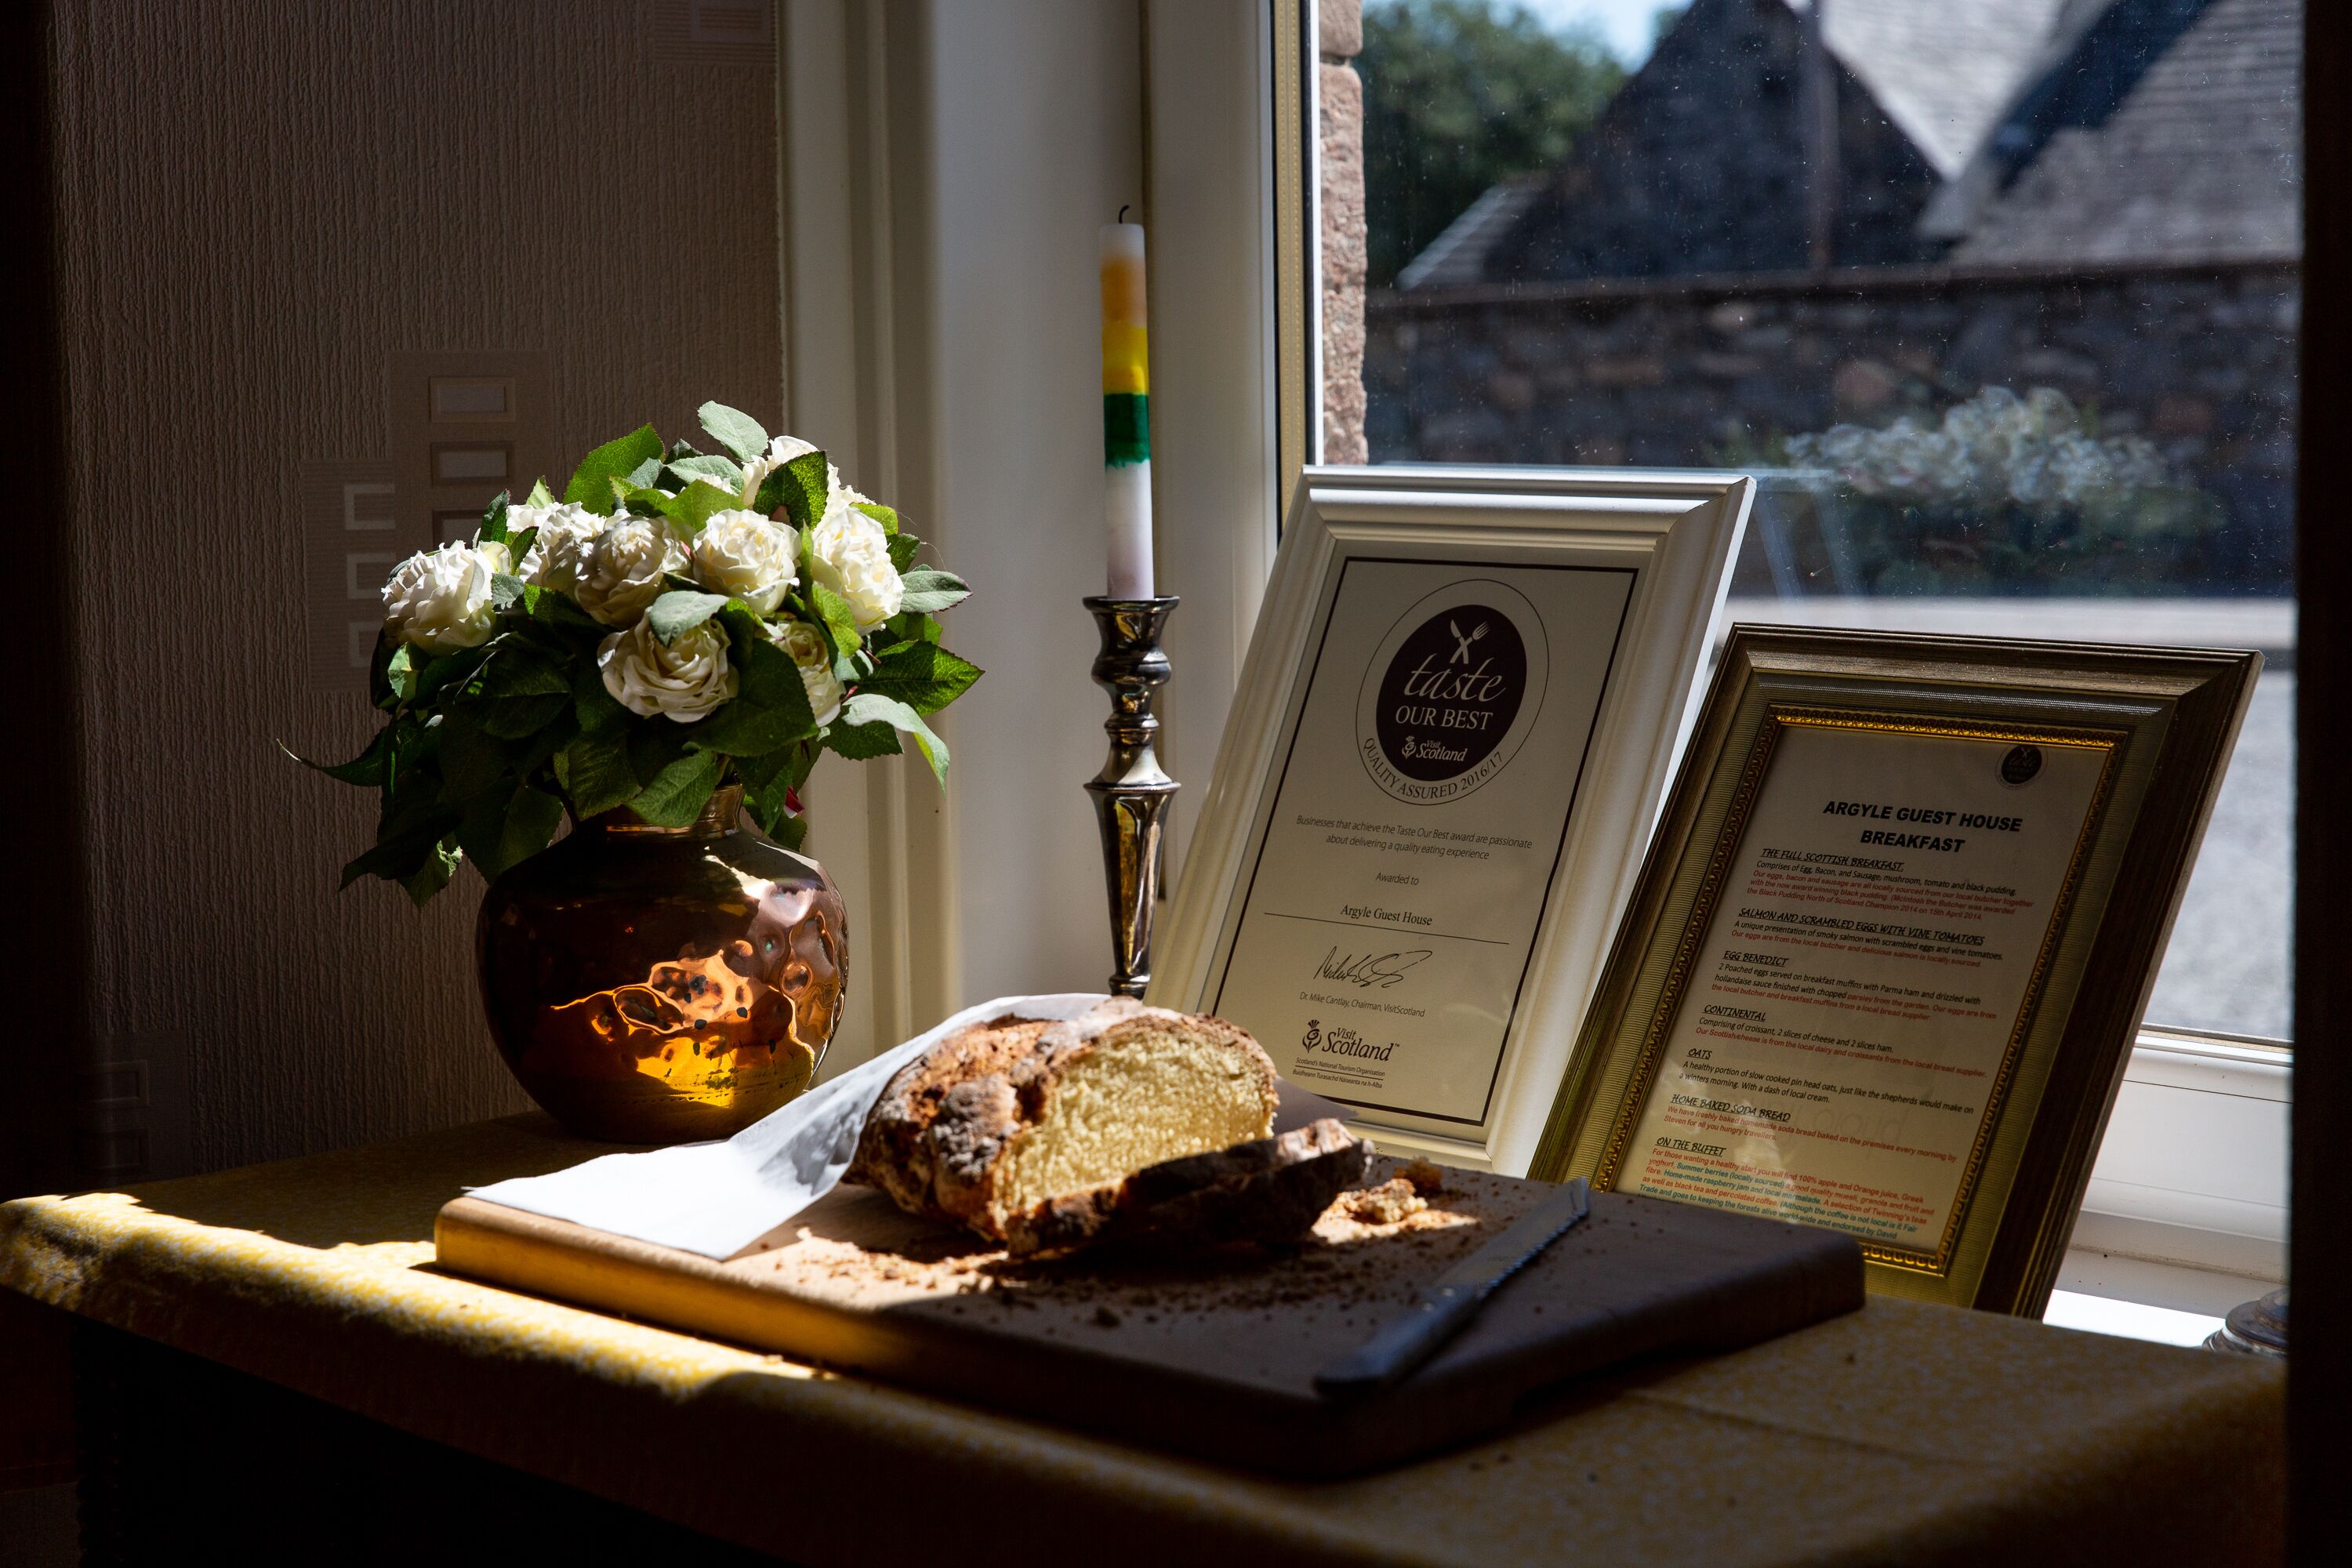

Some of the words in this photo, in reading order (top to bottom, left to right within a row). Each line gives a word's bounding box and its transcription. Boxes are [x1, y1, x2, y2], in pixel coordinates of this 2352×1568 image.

[1403, 653, 1506, 702] taste
[1396, 706, 1436, 727] OUR
[1441, 710, 1493, 731] BEST
[1416, 742, 1467, 761] Scotland
[1425, 740, 1441, 750] Visit
[1363, 738, 1400, 788] QUALITY
[1398, 782, 1458, 799] ASSURED
[1461, 751, 1503, 791] 2016/17
[1822, 800, 1893, 818] ARGYLE
[1896, 808, 1956, 825] GUEST
[1958, 813, 2023, 832] HOUSE
[1296, 815, 1334, 827] Businesses
[1336, 819, 1351, 829] that
[1352, 821, 1381, 832] achieve
[1382, 824, 1395, 833] the
[1397, 825, 1416, 836] Taste
[1417, 827, 1432, 837] Our
[1432, 829, 1449, 839] Best
[1450, 833, 1475, 841] award
[1488, 837, 1532, 848] passionate
[1860, 829, 1965, 852] BREAKFAST
[1326, 833, 1348, 844] about
[1349, 836, 1386, 851] delivering
[1394, 842, 1420, 854] quality
[1421, 845, 1445, 856] eating
[1446, 848, 1489, 859] experience
[1760, 848, 1780, 857] THE
[1780, 850, 1802, 859] FULL
[1803, 852, 1850, 865] SCOTTISH
[1375, 872, 1410, 884] Awarded
[1410, 877, 1418, 885] to
[1756, 860, 1790, 869] Comprises
[1815, 866, 1836, 876] Bacon,
[1852, 870, 1881, 881] Sausage,
[1883, 875, 1922, 885] mushroom,
[1924, 879, 1949, 887] tomato
[1965, 882, 1984, 891] black
[1340, 904, 1371, 919] Argyle
[1374, 908, 1400, 921] Guest
[1402, 912, 1432, 925] House
[1738, 907, 1777, 920] SALMON
[1774, 913, 1798, 922] AND
[1798, 915, 1853, 928] SCRAMBLED
[1855, 921, 1878, 931] EGGS
[1879, 924, 1906, 935] WITH
[1907, 927, 1932, 938] VINE
[1933, 931, 1985, 944] TOMATOES
[1764, 925, 1806, 935] presentation
[1816, 931, 1838, 940] smoky
[1881, 939, 1918, 949] scrambled
[1968, 949, 2002, 960] tomatoes.
[1722, 950, 1741, 960] EGG
[1740, 953, 1789, 966] BENEDICT
[1724, 964, 1752, 973] Poached
[1803, 974, 1835, 985] breakfast
[1835, 979, 1862, 989] muffins
[1880, 984, 1902, 994] Parma
[1904, 987, 1919, 996] ham
[1936, 992, 1964, 1002] drizzled
[1299, 991, 1308, 1000] Dr.
[1308, 993, 1324, 1003] Mike
[1325, 995, 1349, 1007] Cantlay,
[1351, 999, 1381, 1011] Chairman,
[1384, 1004, 1425, 1017] VisitScotland
[1704, 1004, 1766, 1020] CONTINENTAL
[1336, 1027, 1356, 1039] Visit
[1699, 1017, 1736, 1030] Comprising
[1744, 1025, 1775, 1036] croissant,
[1783, 1029, 1801, 1038] slices
[1811, 1034, 1835, 1044] cheese
[1856, 1040, 1875, 1050] slices
[1876, 1044, 1893, 1052] ham.
[1688, 1048, 1712, 1058] OATS
[1356, 1066, 1385, 1079] Organisation
[1686, 1073, 1709, 1083] winters
[1709, 1078, 1738, 1089] morning.
[1741, 1081, 1757, 1091] With
[1763, 1085, 1780, 1094] dash
[1789, 1089, 1806, 1098] local
[1806, 1094, 1829, 1102] cream.
[1689, 1061, 1714, 1073] healthy
[1748, 1071, 1764, 1080] slow
[1766, 1075, 1790, 1083] cooked
[1803, 1080, 1820, 1088] head
[1838, 1085, 1853, 1094] just
[1853, 1087, 1866, 1096] like
[1867, 1090, 1879, 1098] the
[1880, 1092, 1918, 1105] shepherds
[1919, 1099, 1941, 1109] would
[1942, 1103, 1962, 1112] make
[1671, 1094, 1698, 1105] HOME
[1700, 1099, 1730, 1110] BAKED
[1730, 1104, 1756, 1115] SODA
[1759, 1109, 1791, 1120] BREAD
[1663, 1115, 1686, 1125] Steven
[1686, 1119, 1697, 1127] for
[1705, 1122, 1719, 1131] you
[1719, 1124, 1744, 1135] hungry
[1743, 1128, 1778, 1141] travellers.
[1657, 1137, 1671, 1146] ON
[1672, 1139, 1690, 1149] THE
[1691, 1142, 1726, 1155] BUFFET
